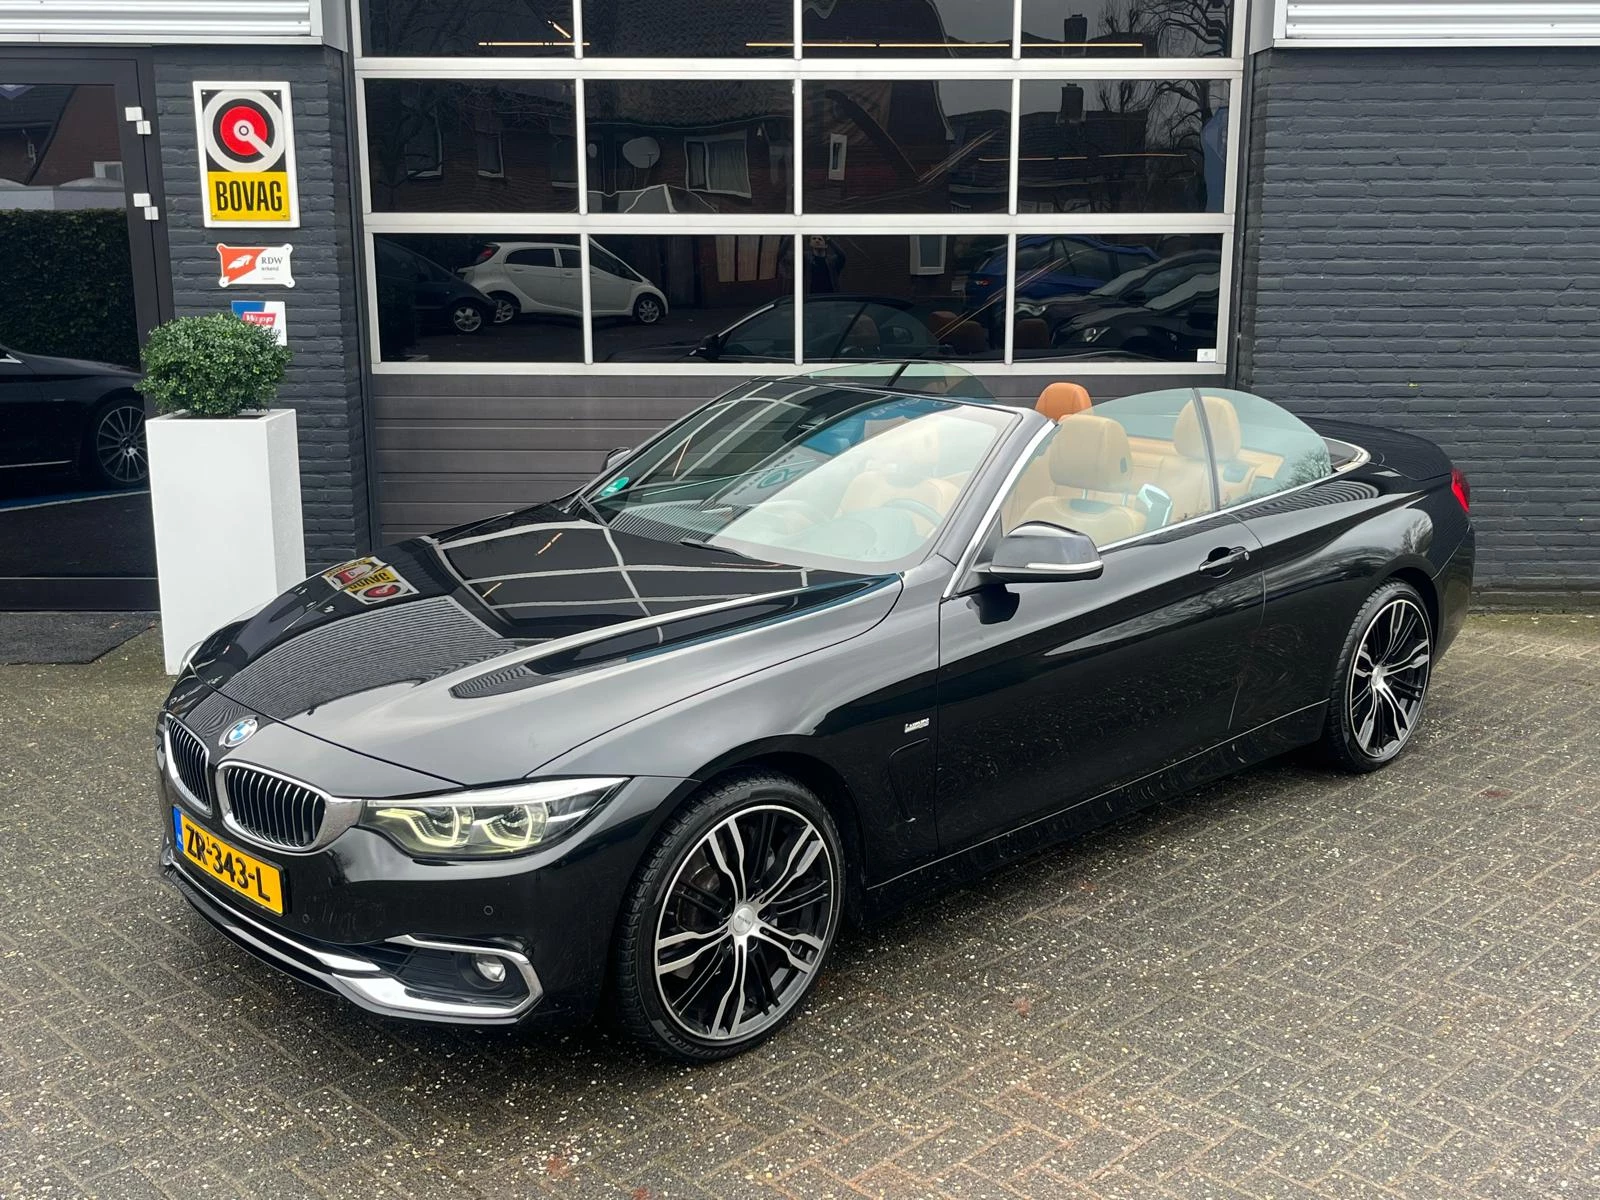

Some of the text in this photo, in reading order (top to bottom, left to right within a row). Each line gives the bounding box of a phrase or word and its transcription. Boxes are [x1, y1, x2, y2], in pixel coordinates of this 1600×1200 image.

[215, 180, 282, 212] BOVAG
[261, 256, 283, 265] RDW
[187, 826, 270, 901] ZR-343-L
